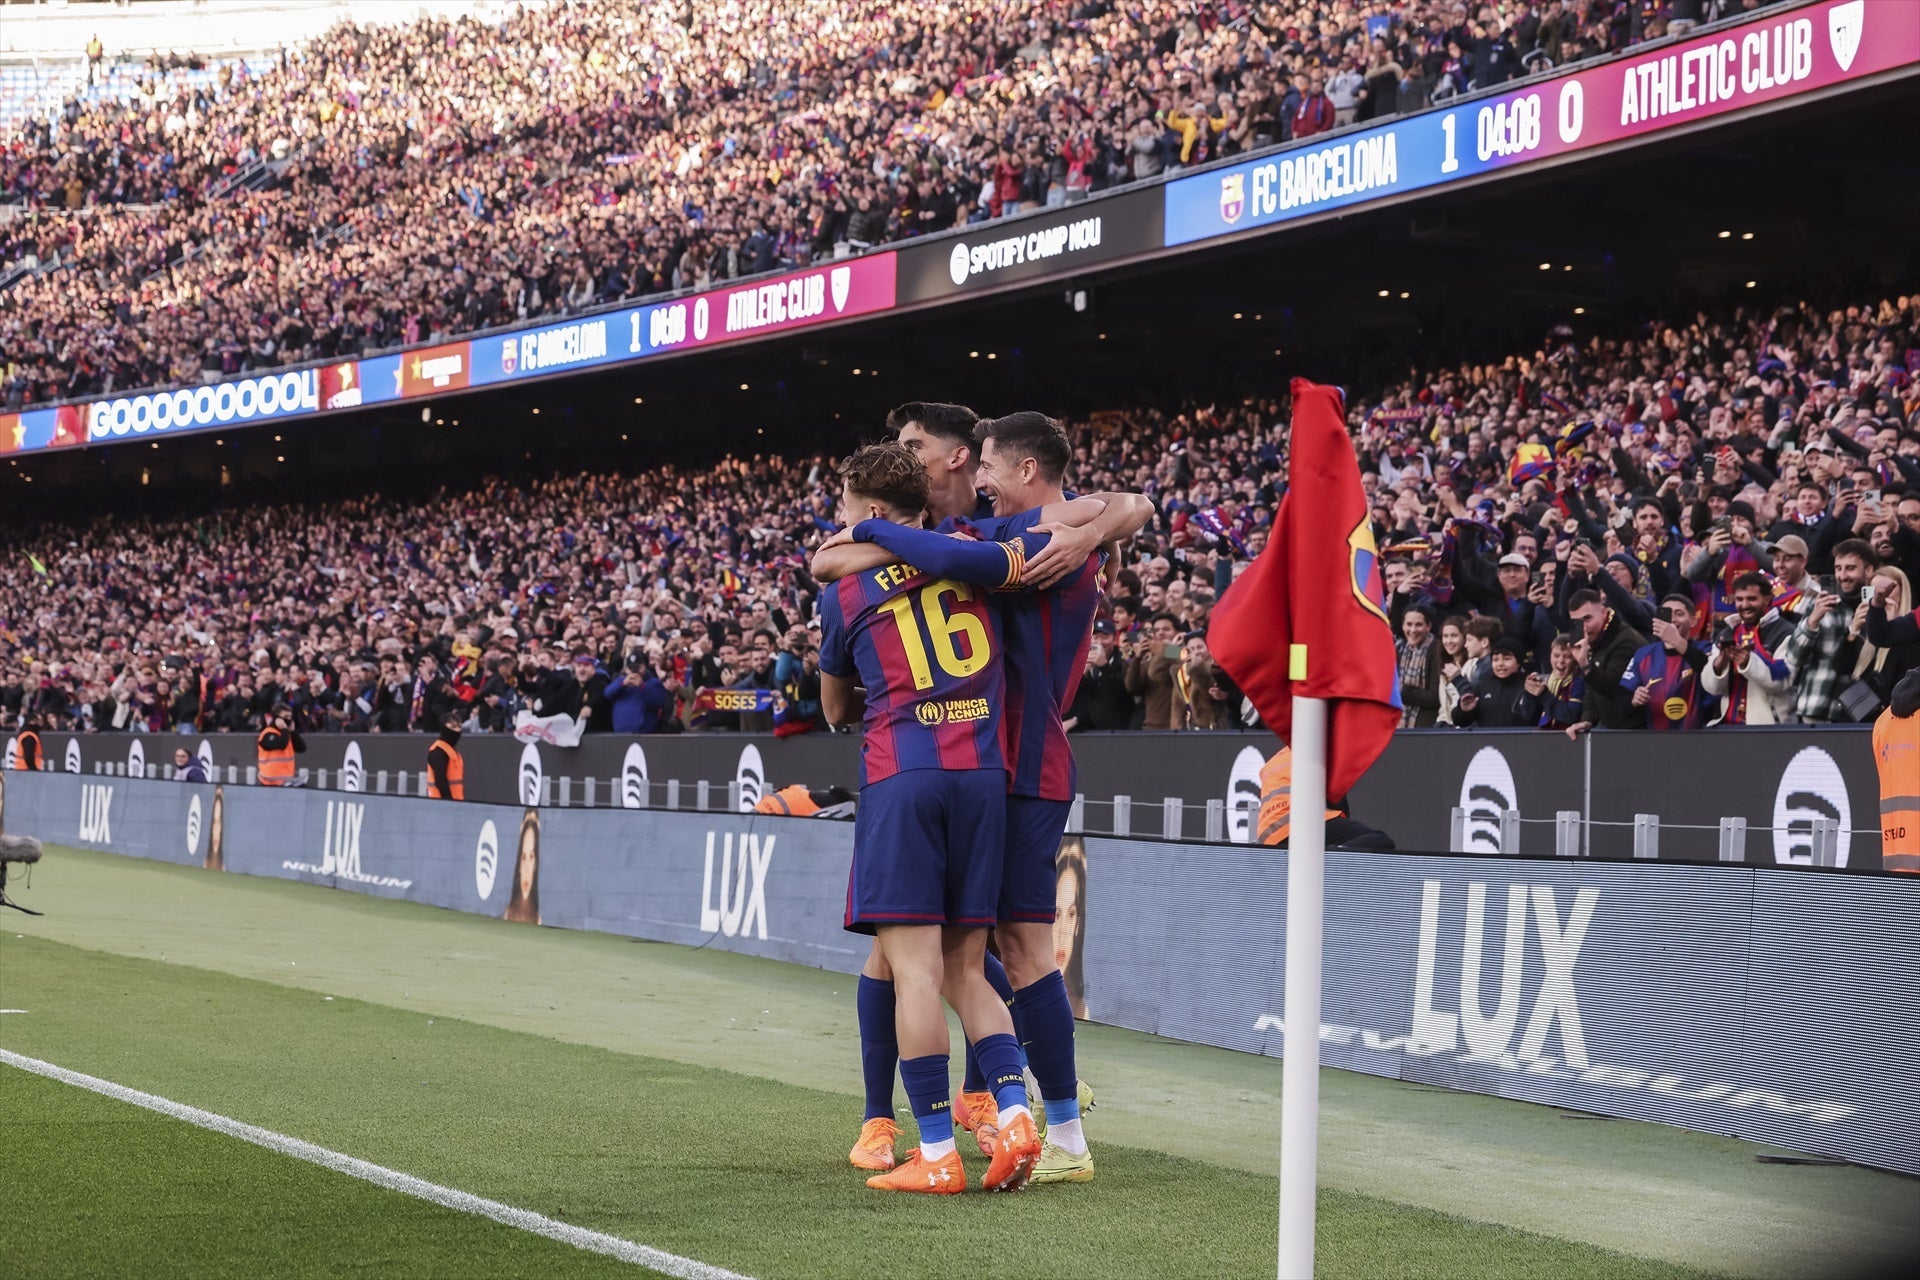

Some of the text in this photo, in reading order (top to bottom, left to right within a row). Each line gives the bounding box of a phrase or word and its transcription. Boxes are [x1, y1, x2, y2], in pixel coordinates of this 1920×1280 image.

[1251, 18, 1812, 217] FC BARCELONA 1 04:08 0 ATHLETIC CLUB
[970, 217, 1101, 275] SPOTIFY CAMP NOU
[521, 333, 537, 371] FC
[538, 320, 607, 368] BARCELONA
[629, 311, 641, 353] 1
[693, 297, 709, 341] 0
[726, 282, 787, 333] ATHLETIC
[788, 274, 825, 320] CLUB
[91, 370, 317, 437] GOOOOOOOOOL
[877, 578, 991, 691] 16
[714, 694, 757, 710] SOSES
[945, 698, 988, 711] UNHCR
[947, 706, 990, 720] ACNUR
[79, 784, 114, 844] LUX
[322, 800, 365, 876] LUX
[700, 831, 776, 940] LUX
[1411, 879, 1600, 1069] LUX
